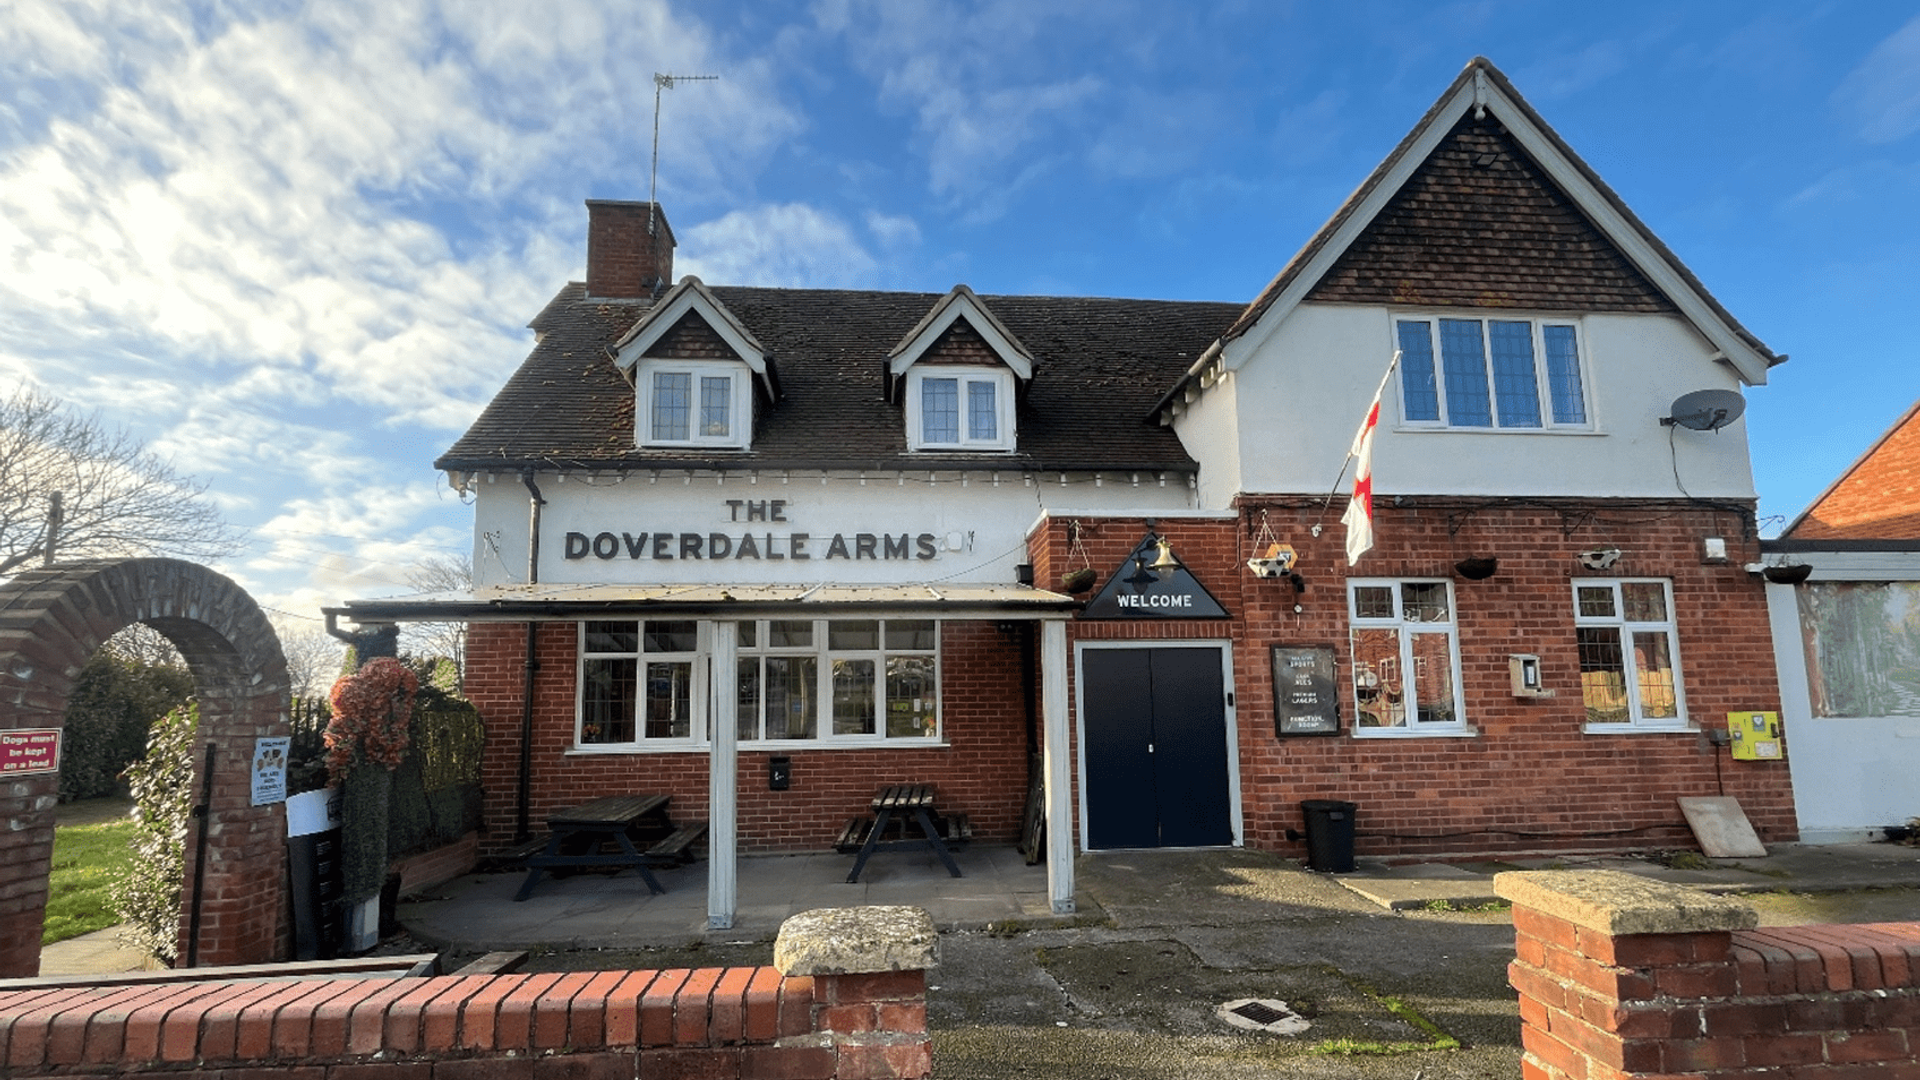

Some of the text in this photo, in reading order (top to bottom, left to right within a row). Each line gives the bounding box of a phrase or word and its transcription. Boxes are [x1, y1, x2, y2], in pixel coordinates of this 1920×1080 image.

[725, 499, 788, 522] THE
[564, 530, 938, 560] DOVERDALE ARMS
[1117, 594, 1192, 608] WELCOME
[2, 735, 55, 746] Dogs must
[9, 747, 47, 757] be kept
[3, 762, 17, 770] on
[28, 759, 50, 768] lead
